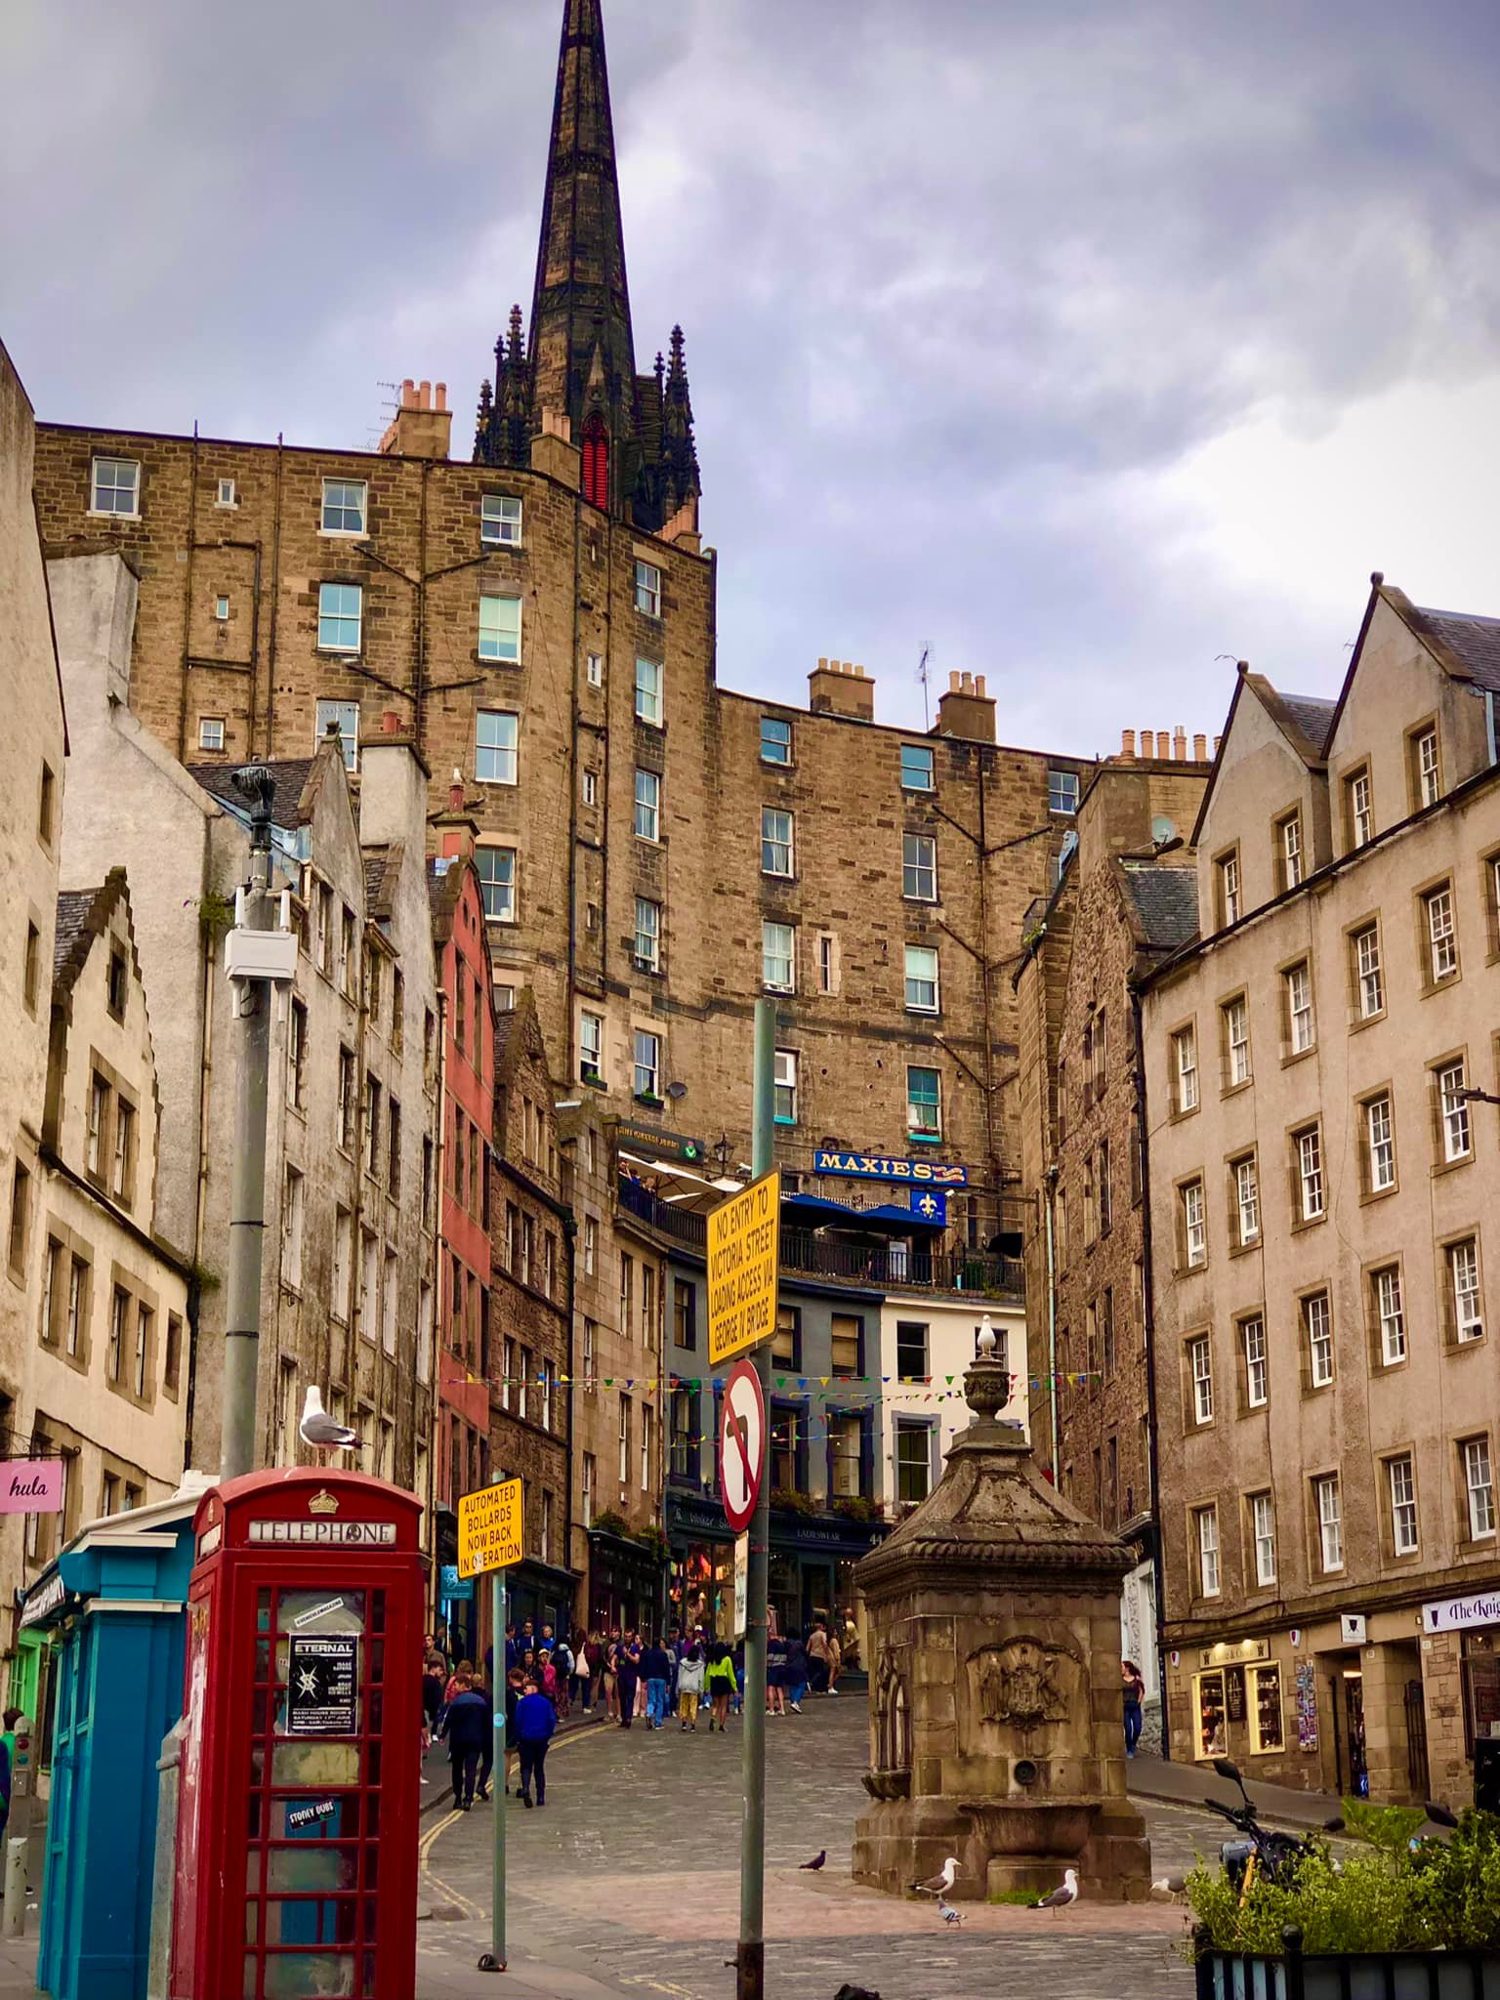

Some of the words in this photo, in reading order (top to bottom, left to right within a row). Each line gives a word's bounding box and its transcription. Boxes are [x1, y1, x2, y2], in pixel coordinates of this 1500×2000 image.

[819, 1153, 932, 1180] MAXIES
[716, 1211, 728, 1244] NO
[730, 1192, 755, 1235] ENTRY
[757, 1185, 769, 1218] TO
[710, 1237, 743, 1282] VICTORIA
[746, 1218, 775, 1262] STREET
[710, 1279, 736, 1319] LOADING
[737, 1263, 761, 1304] ACCESS
[763, 1256, 774, 1289] VIA
[714, 1314, 738, 1352] GEORGE
[747, 1296, 769, 1336] BRIDGE
[9, 1475, 48, 1497] hula
[464, 1484, 516, 1515] AUTOMATED
[255, 1522, 391, 1543] TELEPHONE
[468, 1505, 512, 1533] BOLLARDS
[468, 1532, 487, 1552] NOW
[489, 1524, 512, 1545] BACK
[460, 1558, 469, 1573] IN
[472, 1542, 521, 1570] OERATION
[1449, 1601, 1473, 1620] The
[294, 1644, 354, 1653] ETERNAL
